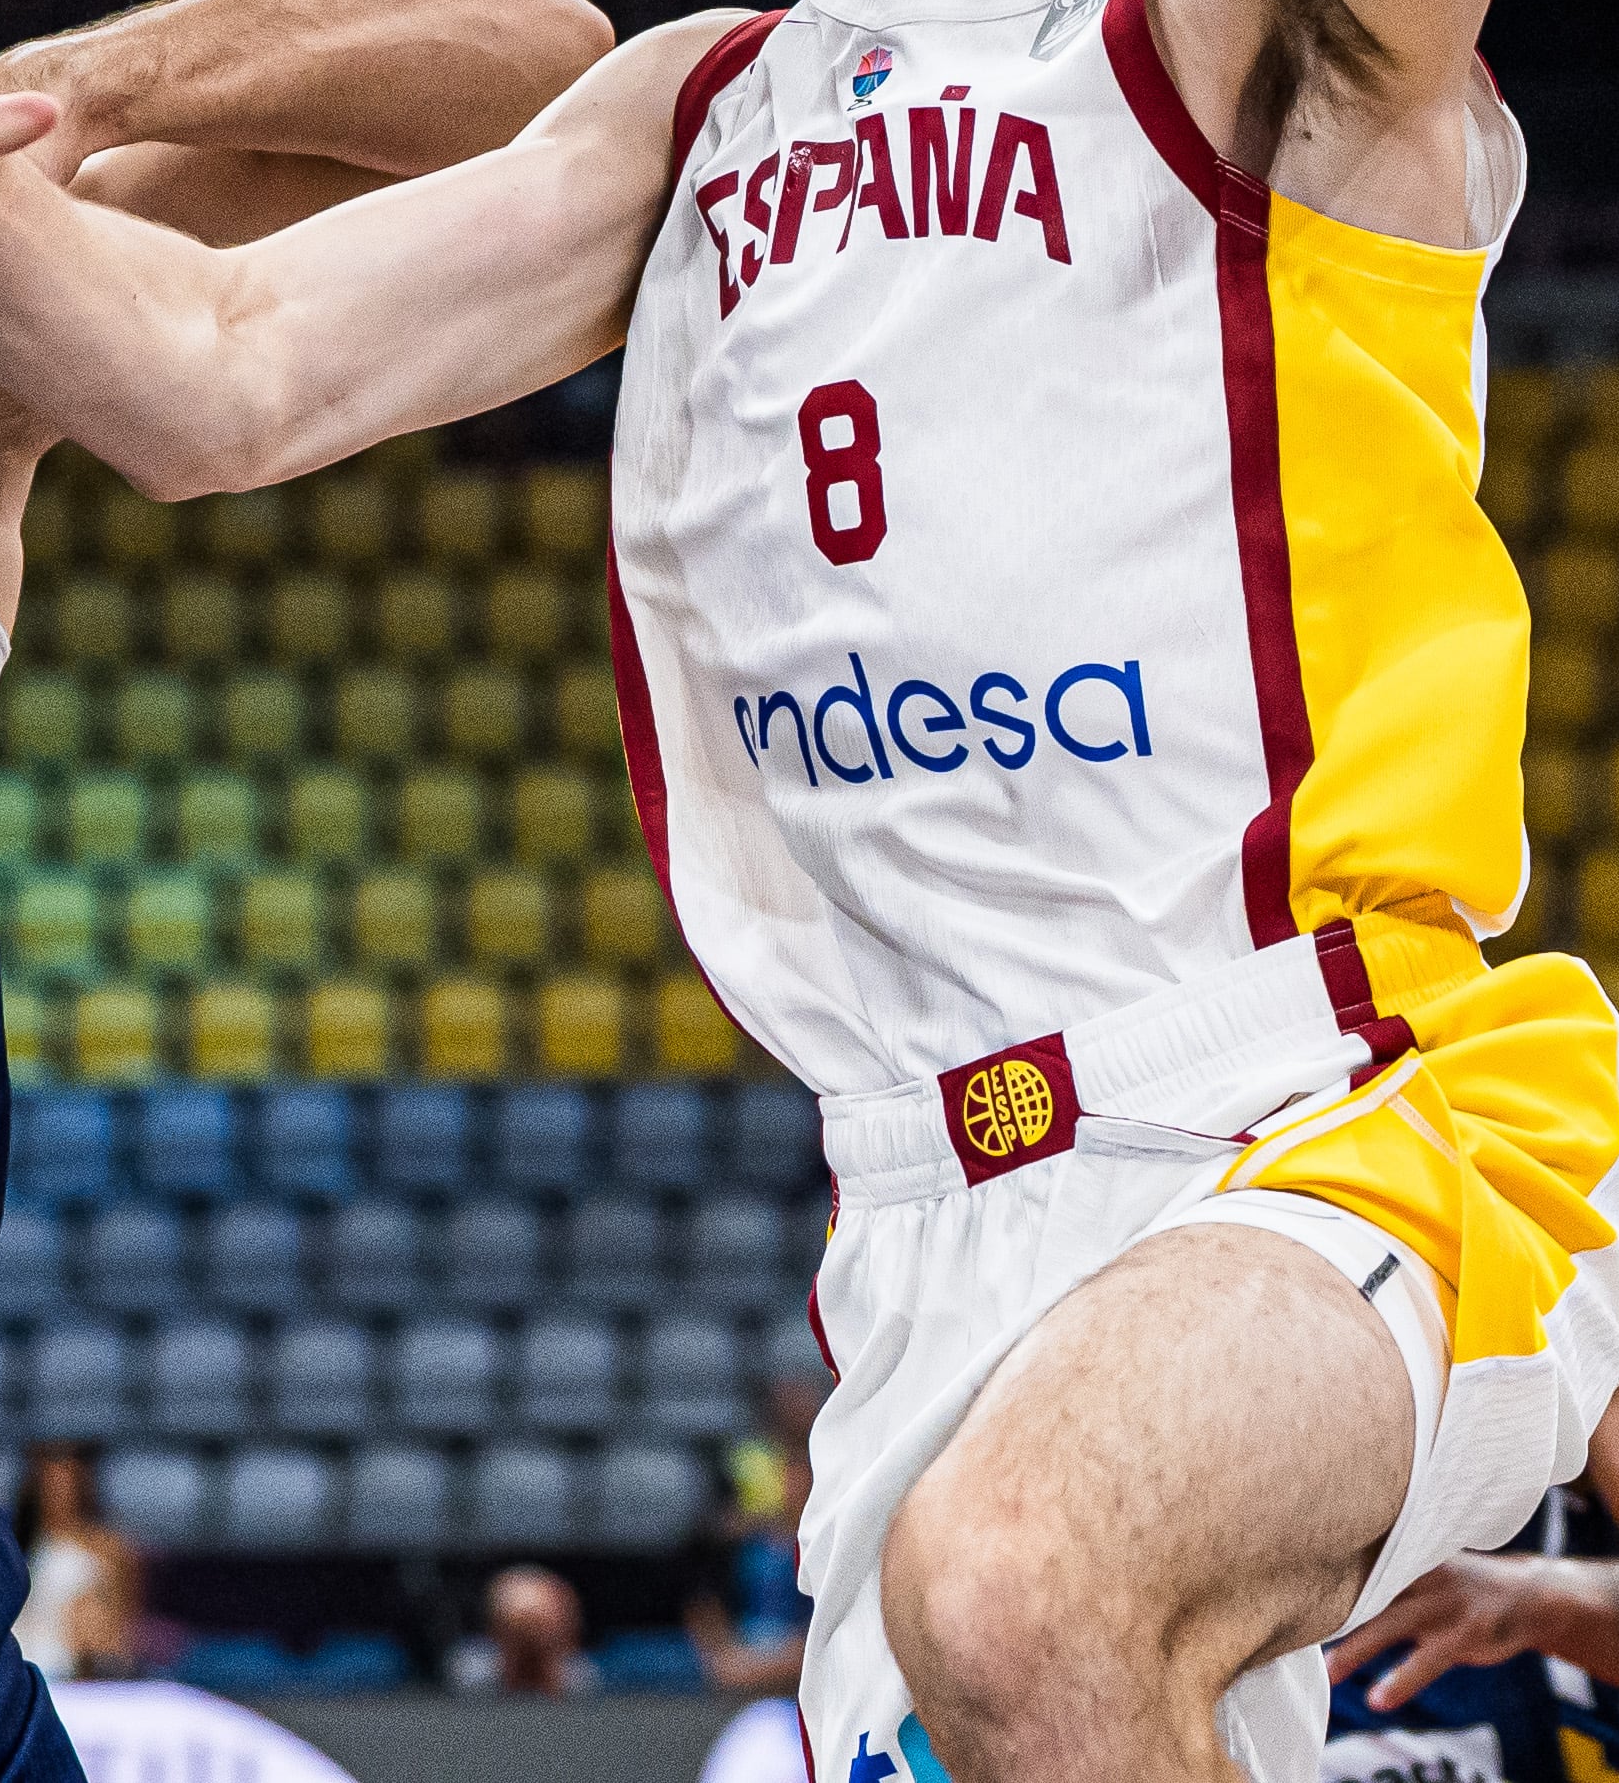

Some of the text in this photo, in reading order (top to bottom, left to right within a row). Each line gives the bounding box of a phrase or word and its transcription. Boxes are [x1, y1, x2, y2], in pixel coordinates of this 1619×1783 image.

[695, 84, 1072, 321] ESPAÑA
[797, 379, 888, 566] 8
[990, 1064, 1017, 1153] ESP
